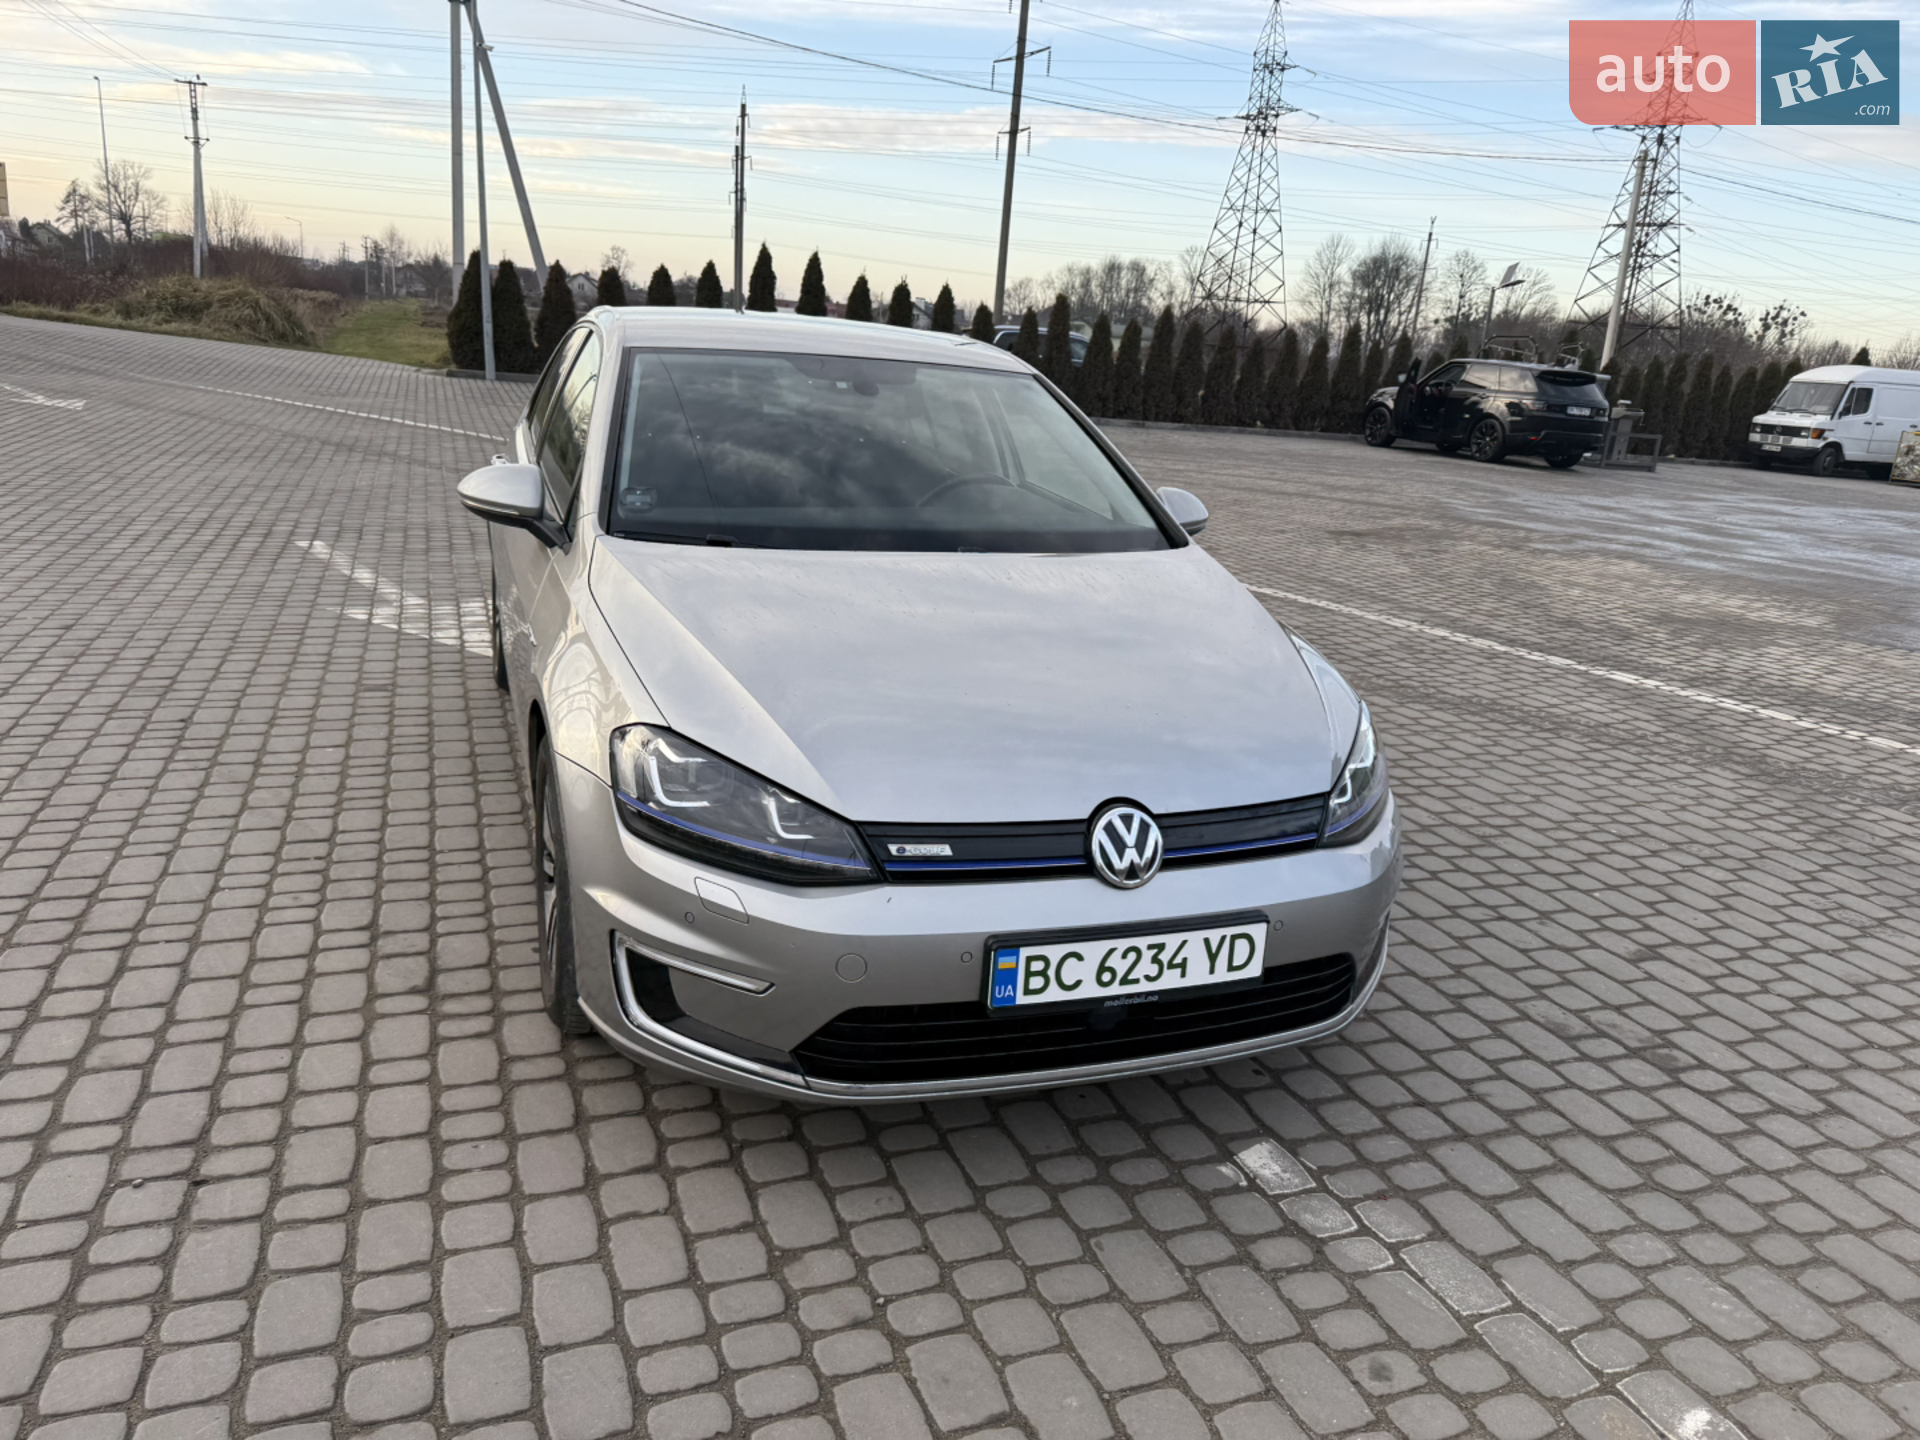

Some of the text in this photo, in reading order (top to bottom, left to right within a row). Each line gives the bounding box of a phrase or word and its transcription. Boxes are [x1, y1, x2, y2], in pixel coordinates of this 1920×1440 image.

[1023, 932, 1256, 996] BC 6234 YD
[995, 984, 1014, 998] UA
